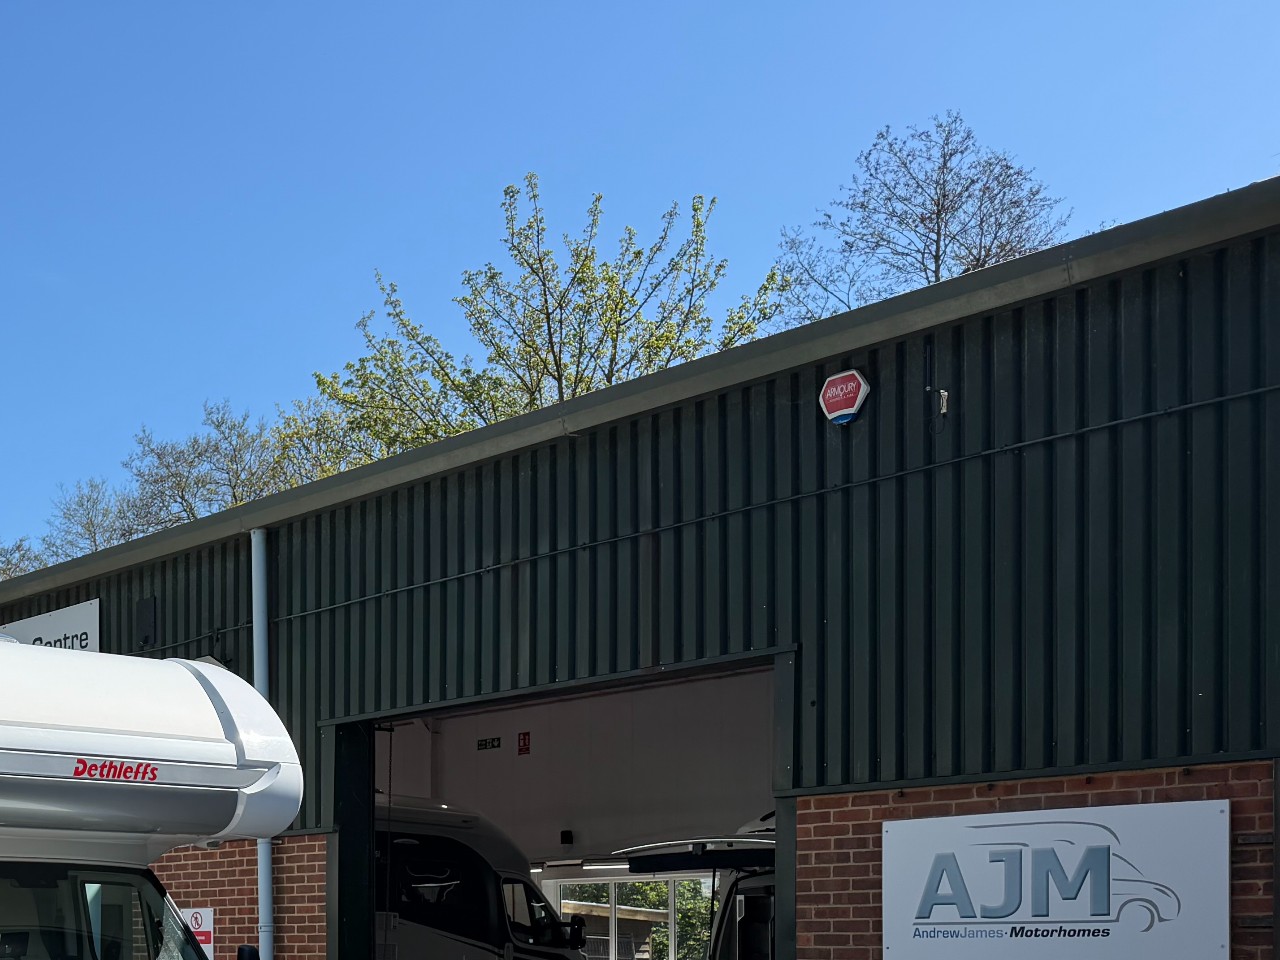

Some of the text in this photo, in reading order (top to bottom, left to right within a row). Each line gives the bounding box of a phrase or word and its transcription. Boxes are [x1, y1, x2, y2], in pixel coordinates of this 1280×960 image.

[826, 381, 857, 399] ARMOURY
[73, 758, 159, 781] Dethleffs
[914, 844, 1111, 920] AJM
